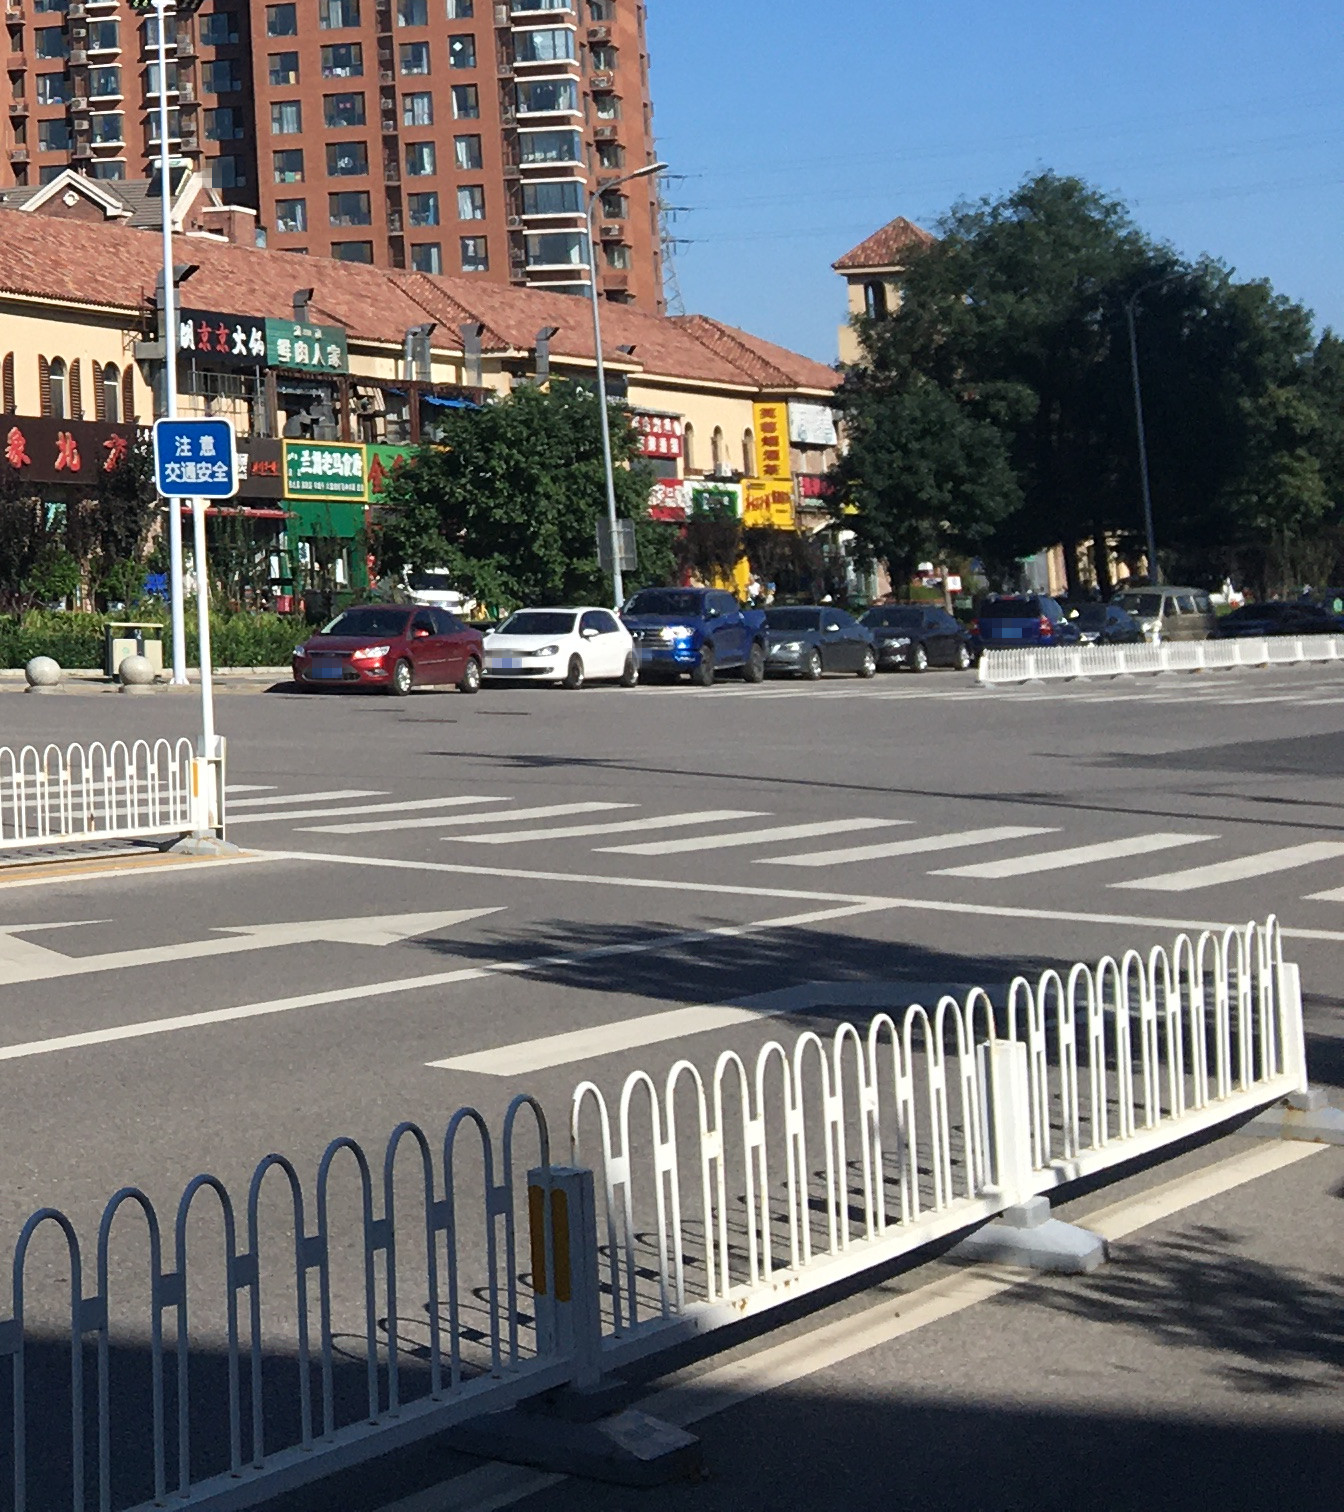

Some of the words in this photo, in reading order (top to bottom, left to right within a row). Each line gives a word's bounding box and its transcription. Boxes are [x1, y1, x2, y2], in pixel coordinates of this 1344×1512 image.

[175, 435, 217, 457] 注意
[164, 461, 229, 483] 交通安全
